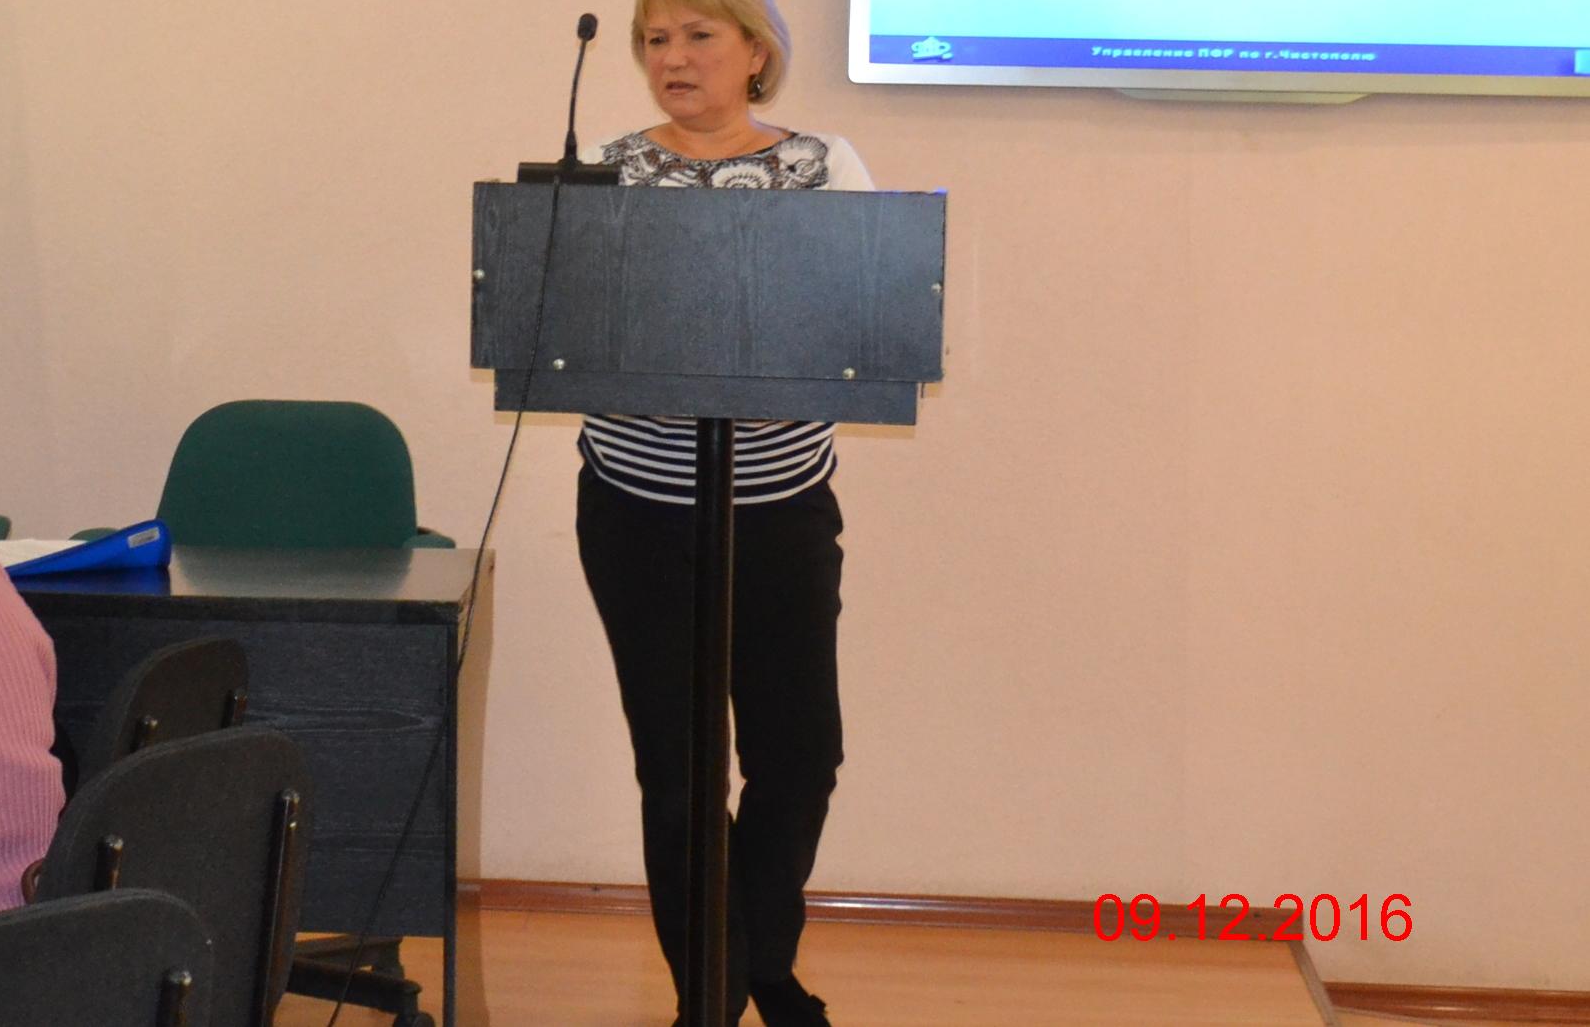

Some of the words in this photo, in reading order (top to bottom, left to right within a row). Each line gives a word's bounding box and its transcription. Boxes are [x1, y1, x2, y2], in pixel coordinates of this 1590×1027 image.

[1091, 46, 1194, 59] Управление
[1198, 48, 1234, 59] ПФР
[1239, 51, 1260, 60] по
[1264, 50, 1376, 62] г.Чистополю
